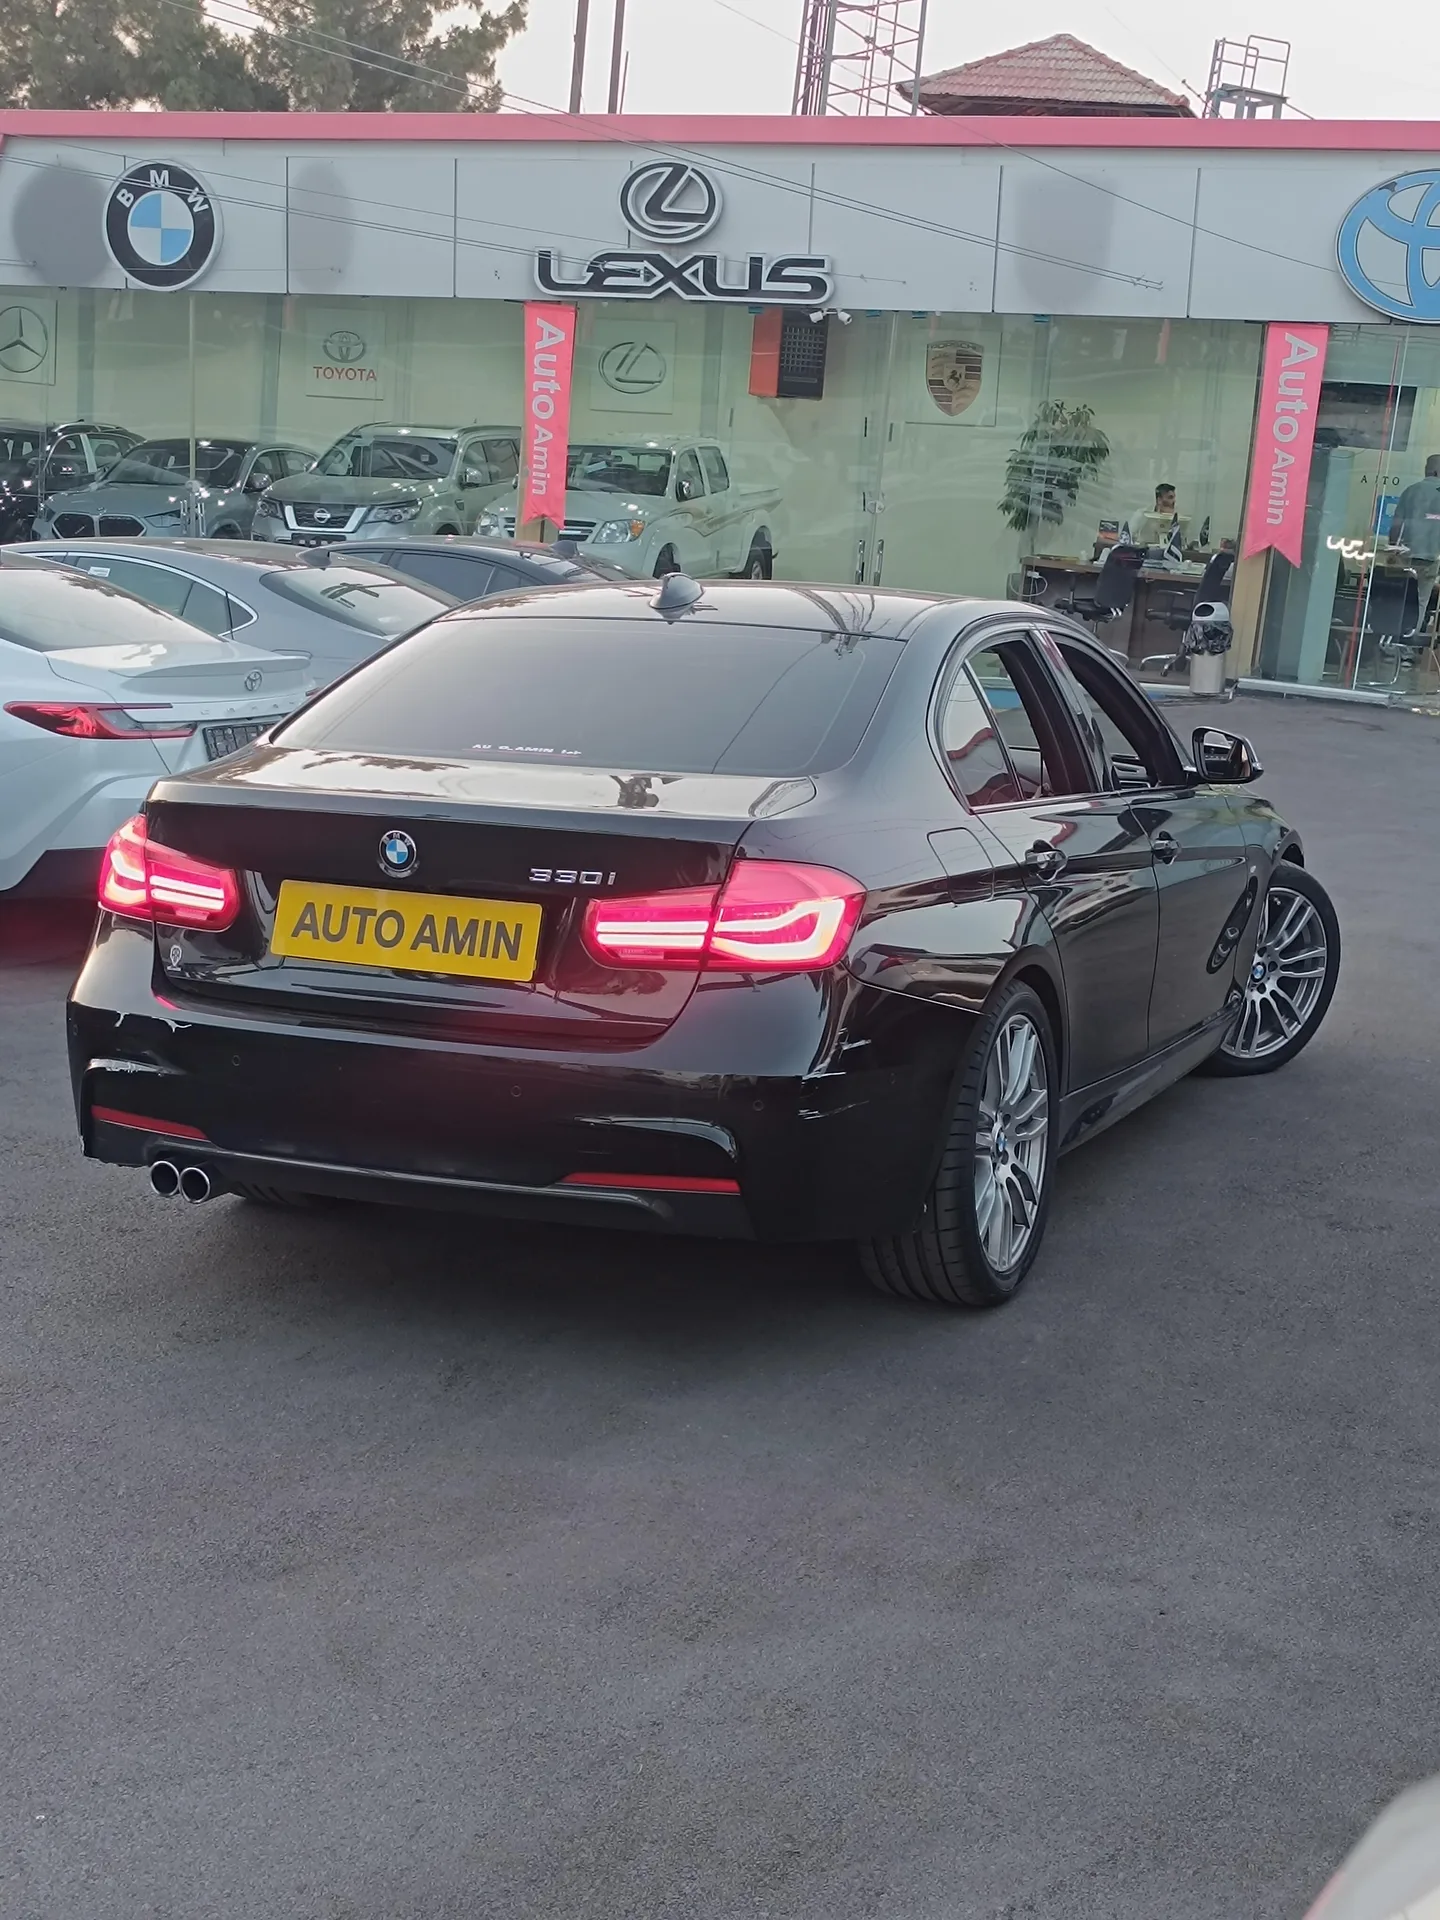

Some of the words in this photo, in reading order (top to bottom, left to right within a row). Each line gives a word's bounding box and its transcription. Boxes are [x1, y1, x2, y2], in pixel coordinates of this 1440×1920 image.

[116, 169, 209, 213] BMW
[535, 248, 831, 303] LEXUS
[313, 366, 377, 382] TOYOTA
[532, 317, 566, 420] Auto
[1273, 332, 1319, 443] Auto
[532, 423, 553, 496] Amin
[1266, 448, 1295, 525] Amin
[529, 868, 616, 886] 330i
[291, 901, 406, 948] AUTO
[410, 913, 523, 962] AMIN
